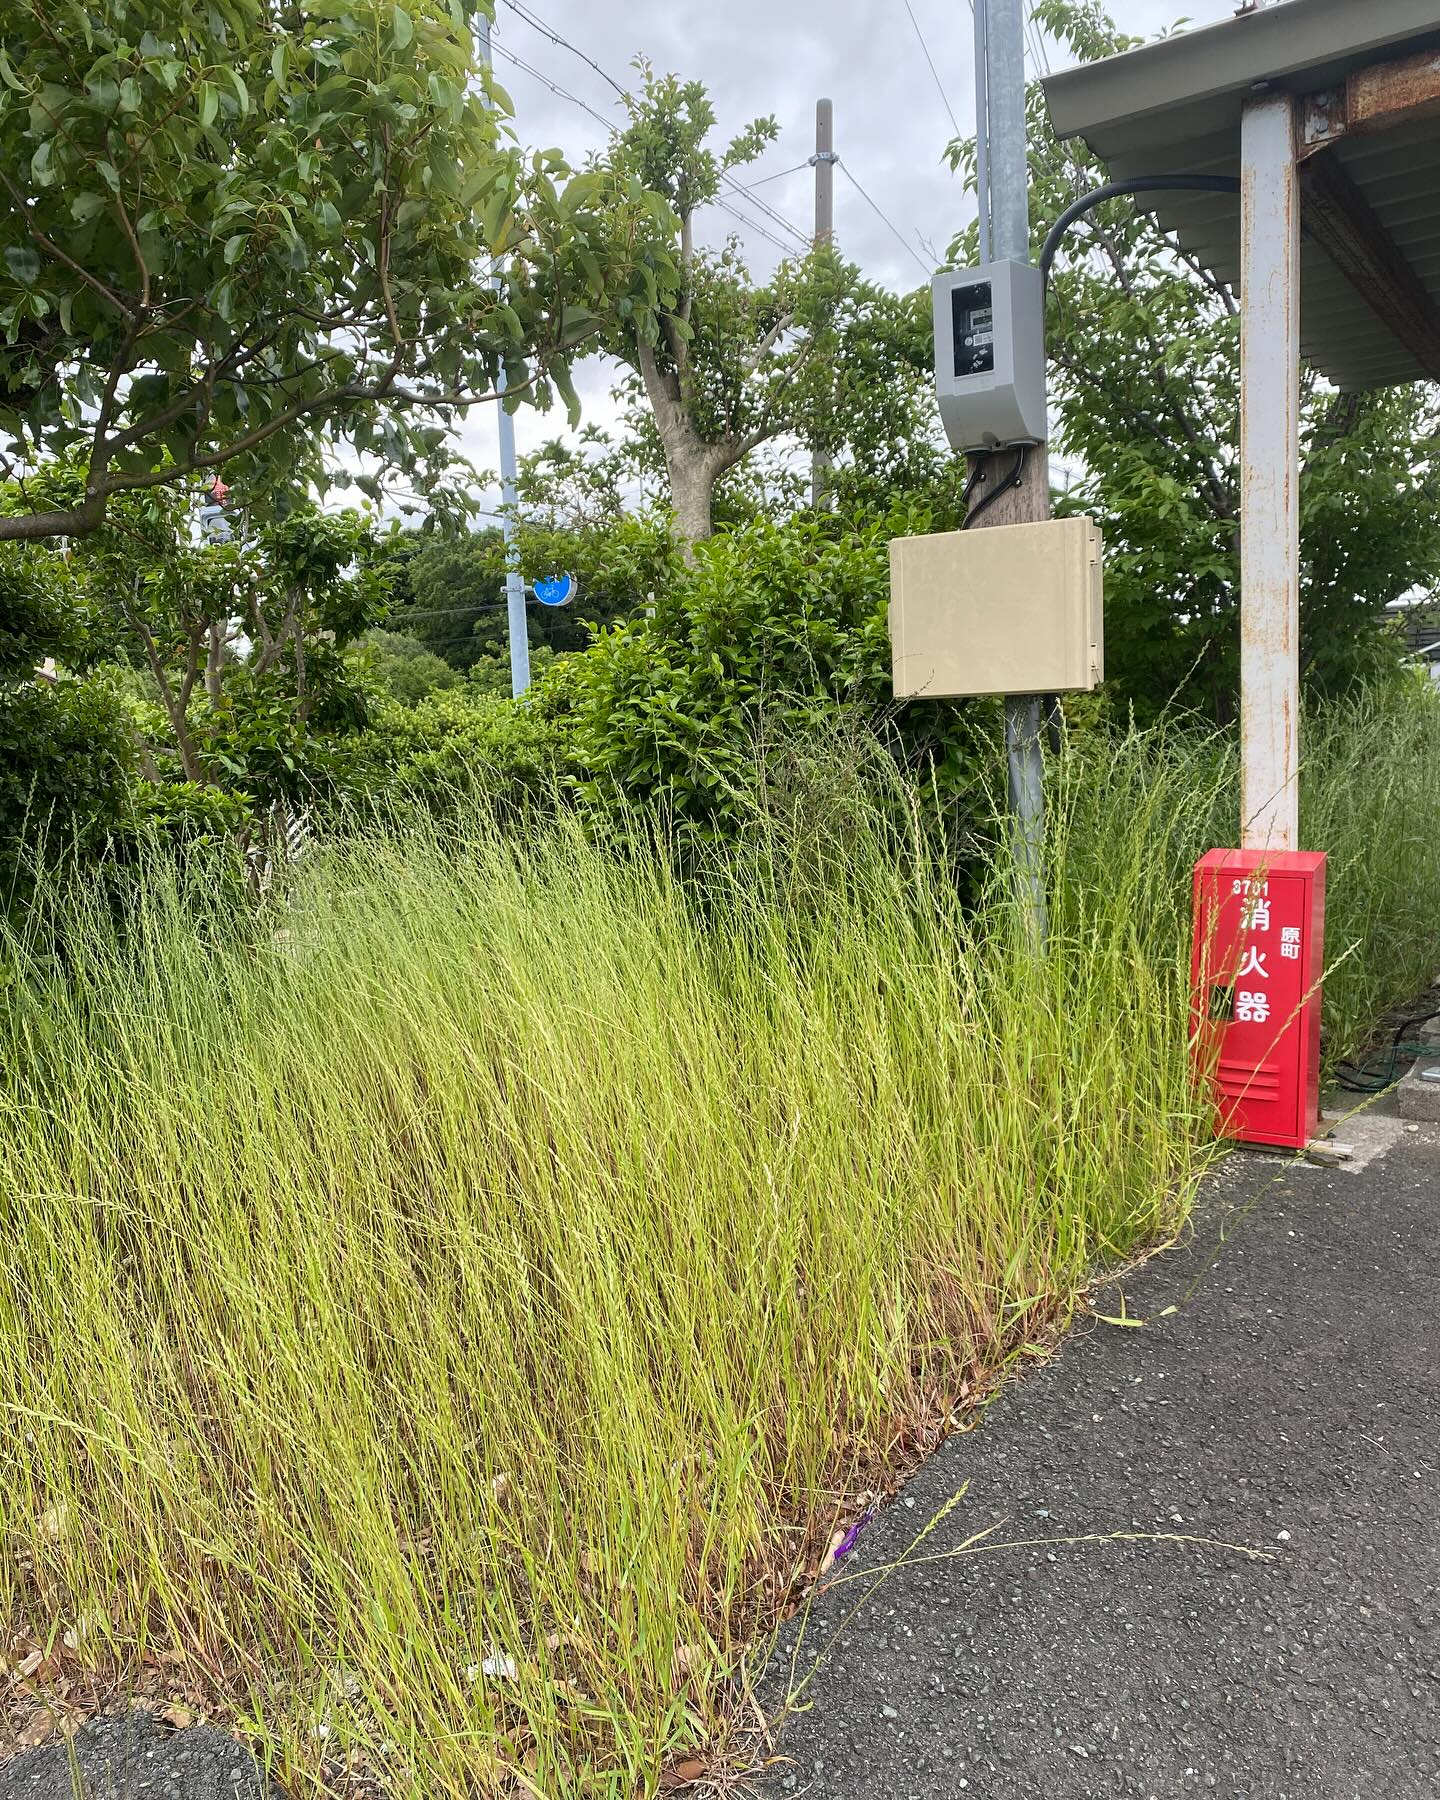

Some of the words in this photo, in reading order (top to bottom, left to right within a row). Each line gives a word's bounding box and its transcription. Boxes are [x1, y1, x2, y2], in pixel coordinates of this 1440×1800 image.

[1236, 898, 1271, 1023] 消火器
[1280, 926, 1301, 960] 原町
